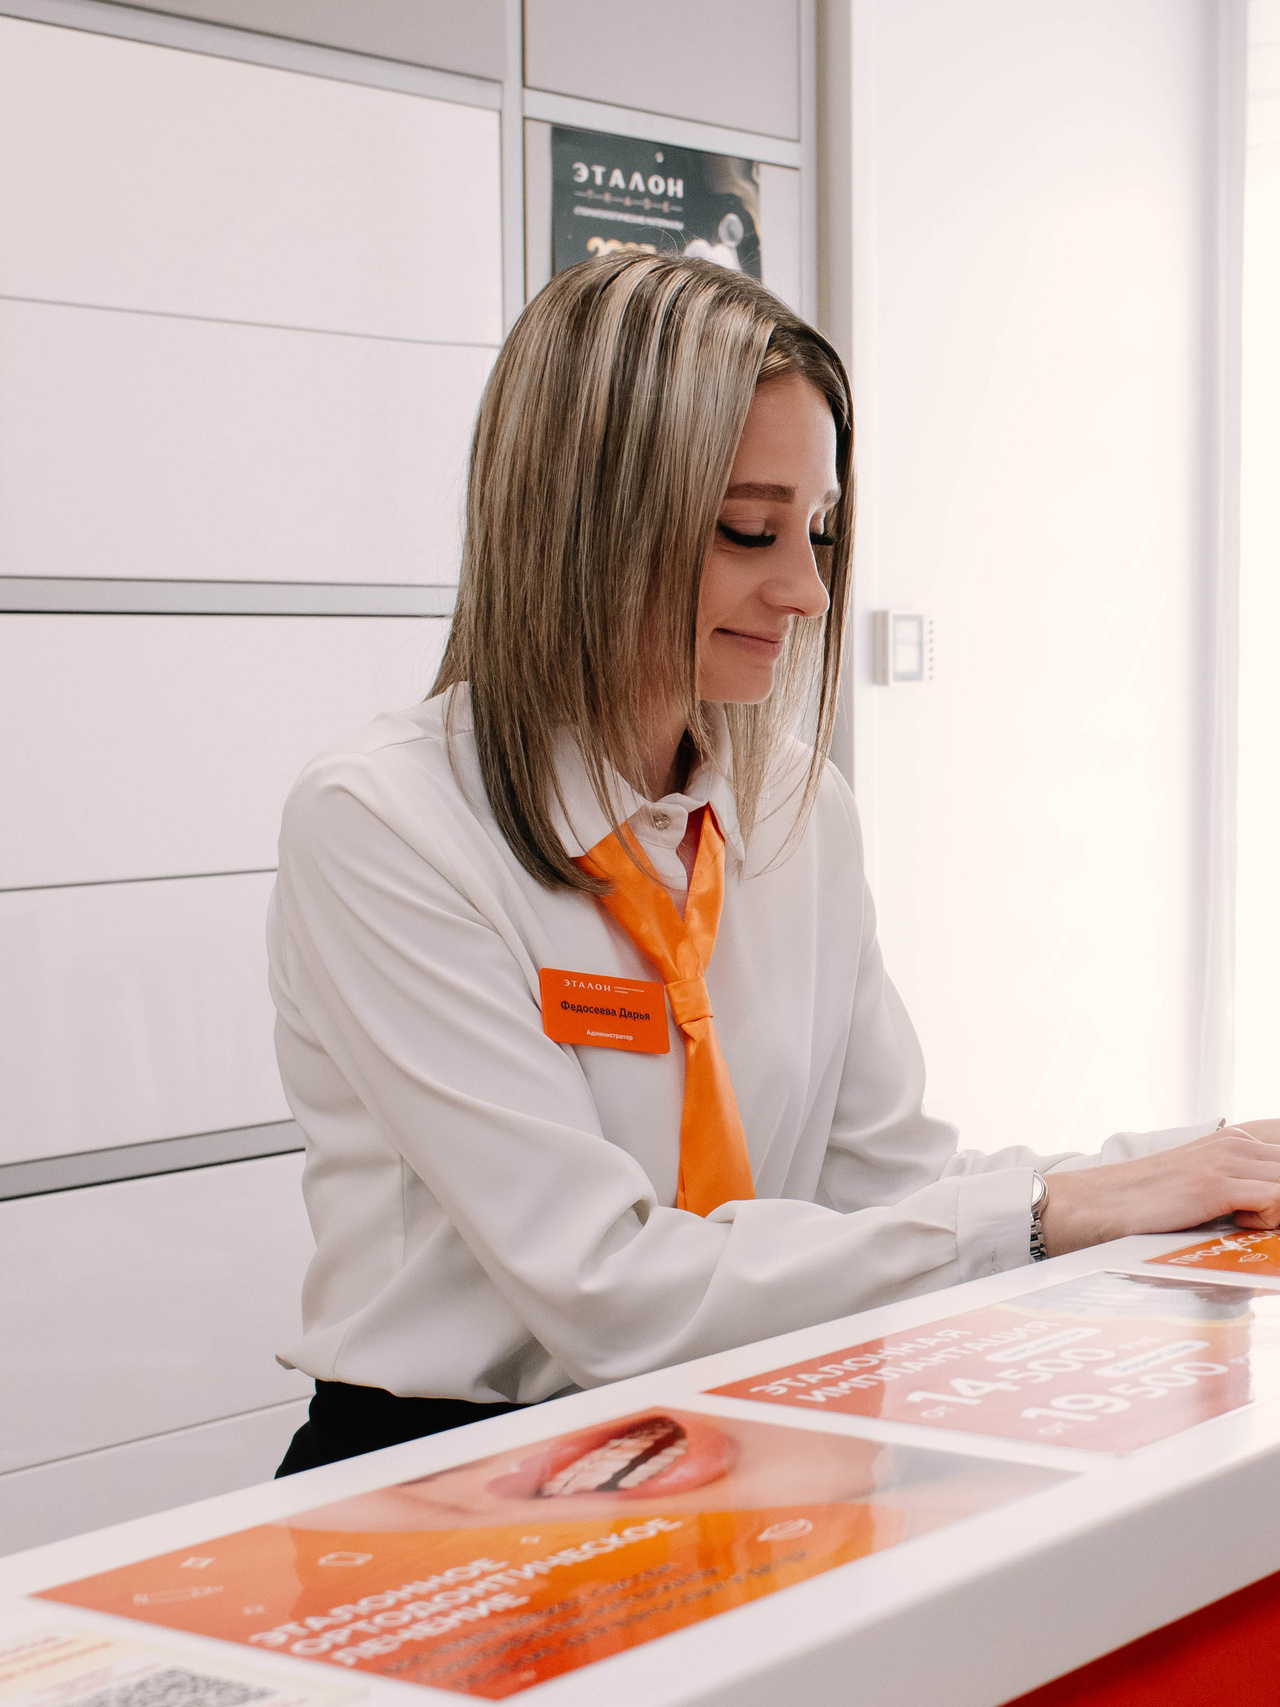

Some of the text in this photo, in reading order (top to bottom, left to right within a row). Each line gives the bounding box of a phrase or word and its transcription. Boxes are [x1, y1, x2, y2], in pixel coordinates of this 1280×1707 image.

[571, 161, 685, 199] ЭТАЛОН
[560, 1000, 651, 1021] Федосеева Дарья
[563, 979, 612, 993] ЭТАЛОН
[586, 1029, 634, 1041] Администратор
[750, 1328, 973, 1397] ЭТАЛОННАЯ
[797, 1319, 1060, 1403] ИМПЛАНТАЦИЯ
[248, 1556, 510, 1648] ЭТАЛОННОЕ
[291, 1517, 683, 1656] ОРТОДОНТИЧЕСКОЕ
[331, 1592, 531, 1667] ЛЕЧЕНИЕ
